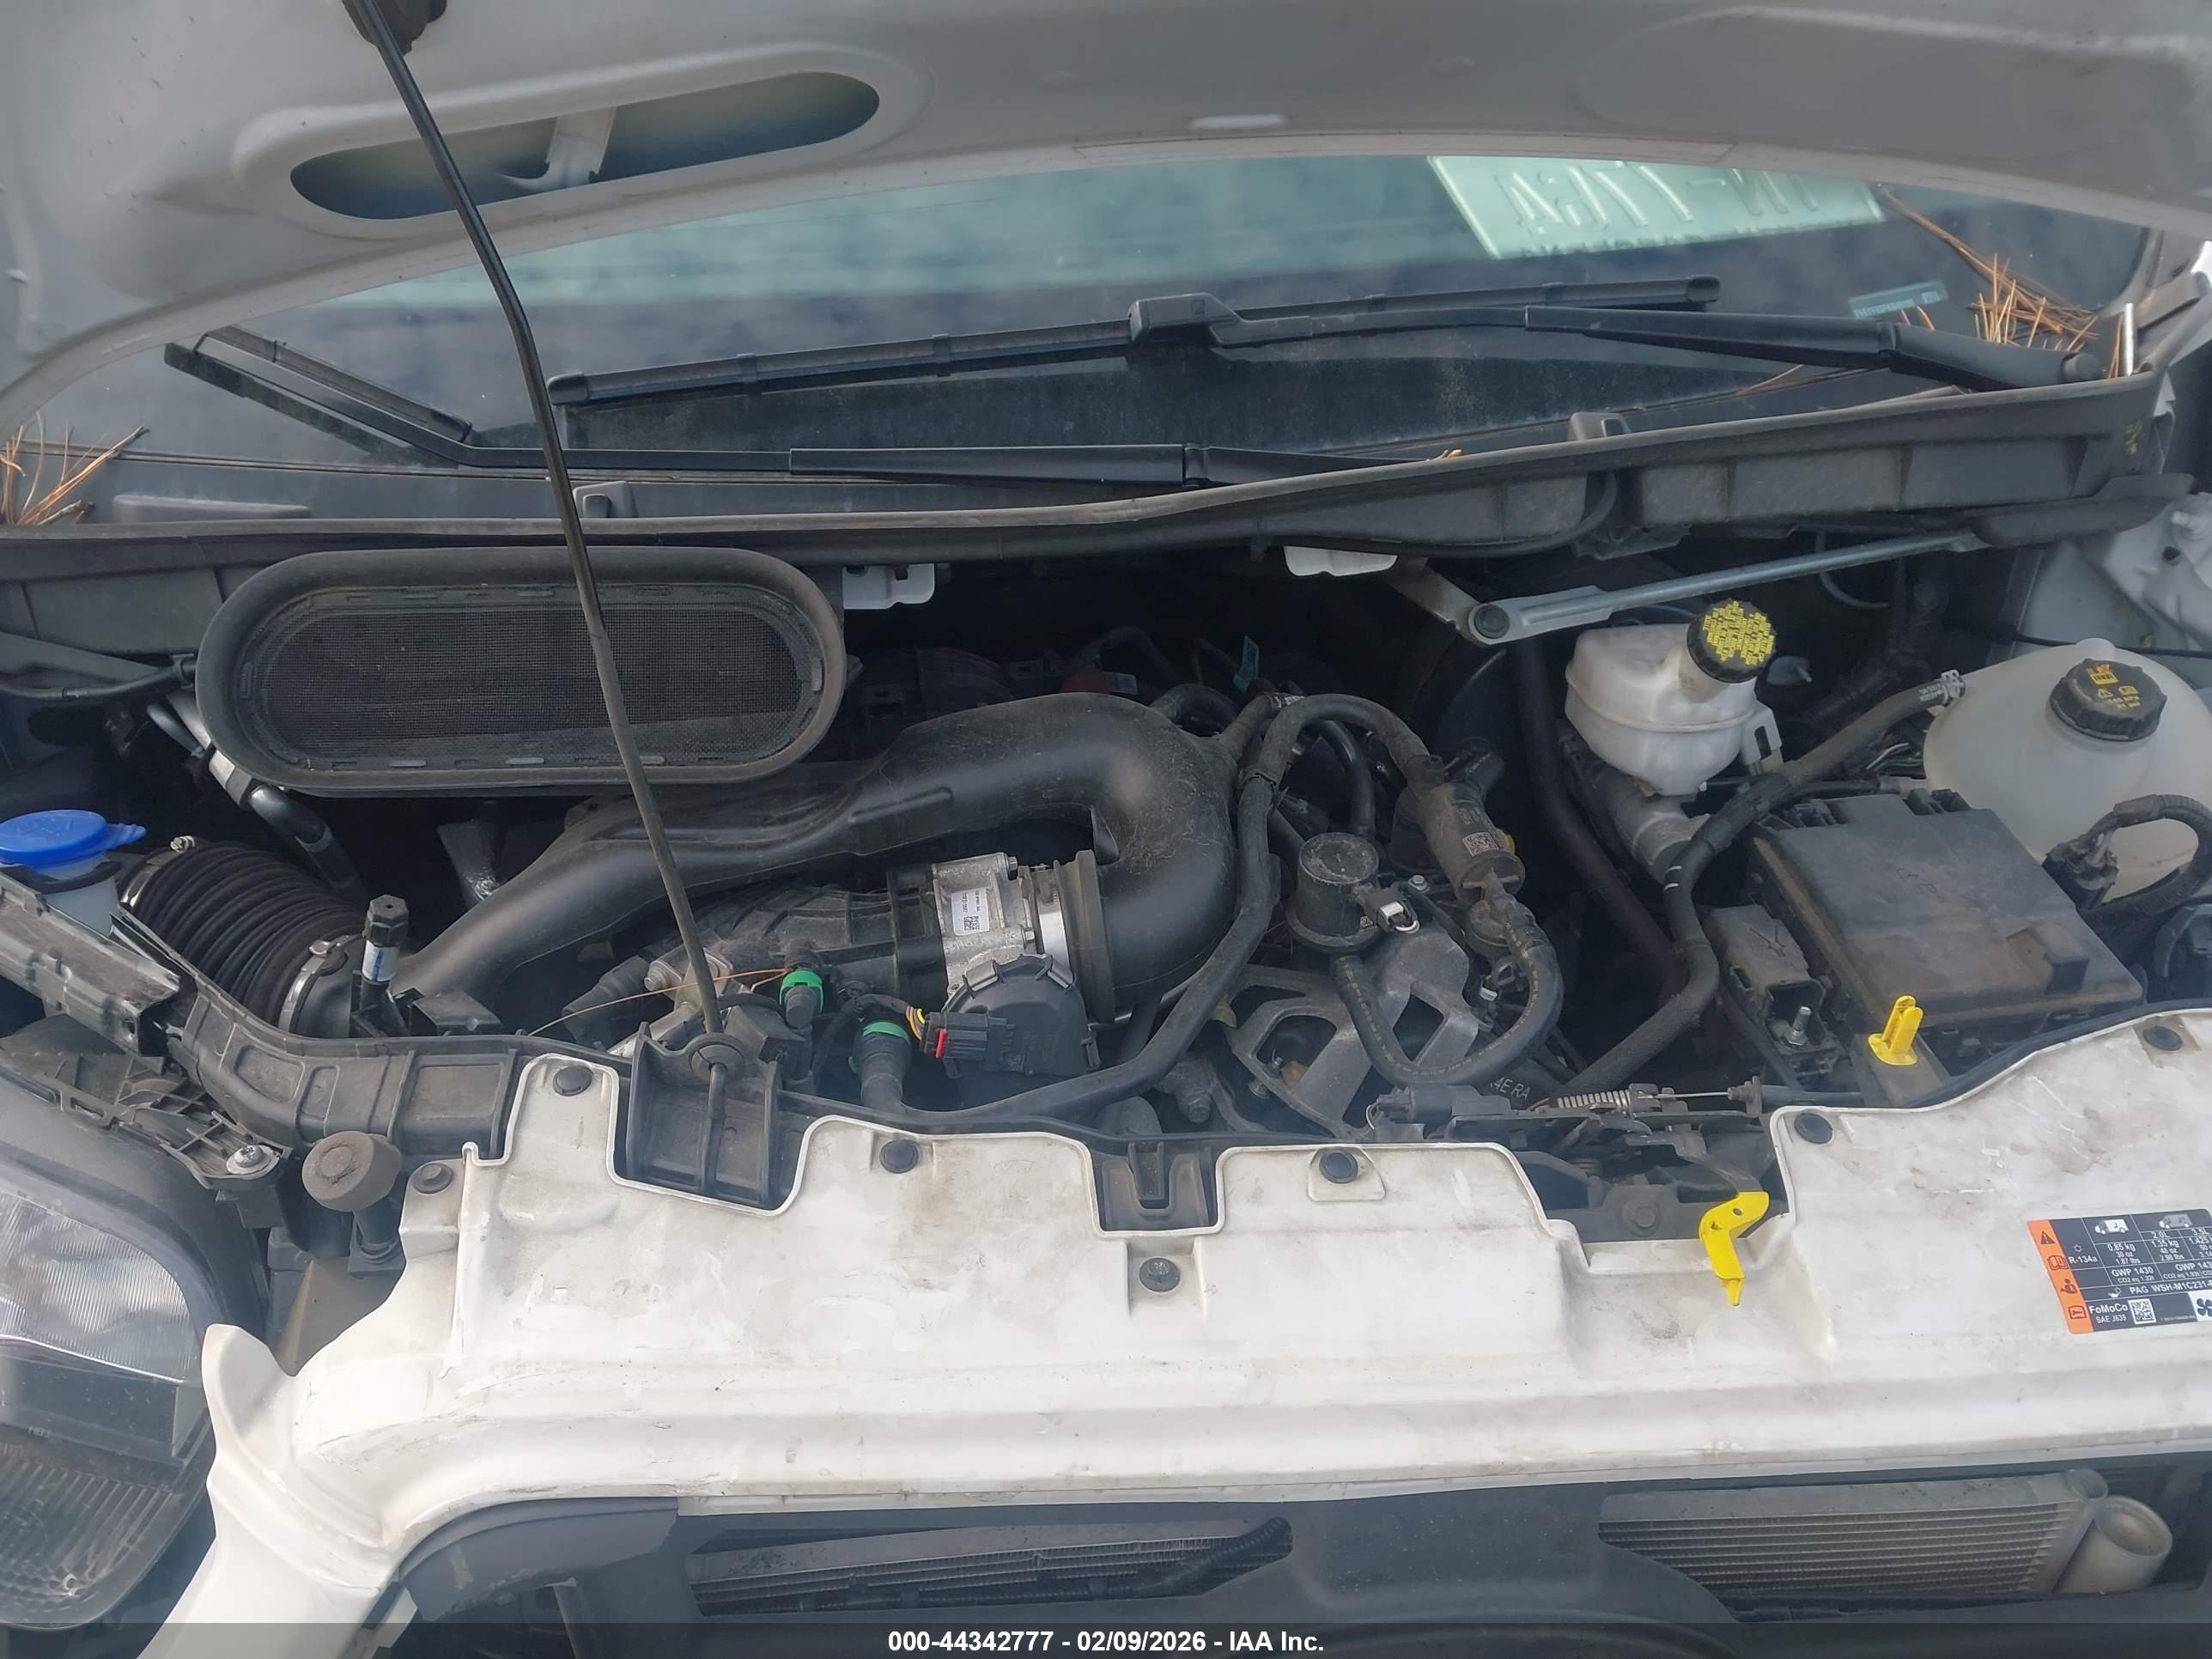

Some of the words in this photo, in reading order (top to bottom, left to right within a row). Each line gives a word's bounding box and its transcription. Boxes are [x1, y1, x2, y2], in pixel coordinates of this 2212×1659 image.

[2124, 1243, 2136, 1252] kg
[2167, 1239, 2180, 1249] kg
[2068, 1255, 2099, 1265] R-134a
[2112, 1268, 2132, 1277] GWP
[2134, 1266, 2154, 1275] 1430
[2174, 1262, 2196, 1272] GWP
[2197, 1261, 2212, 1269] 143
[2130, 1285, 2149, 1294] PAG
[2088, 1303, 2129, 1314] FoMoCo
[2095, 1315, 2111, 1324] SAE
